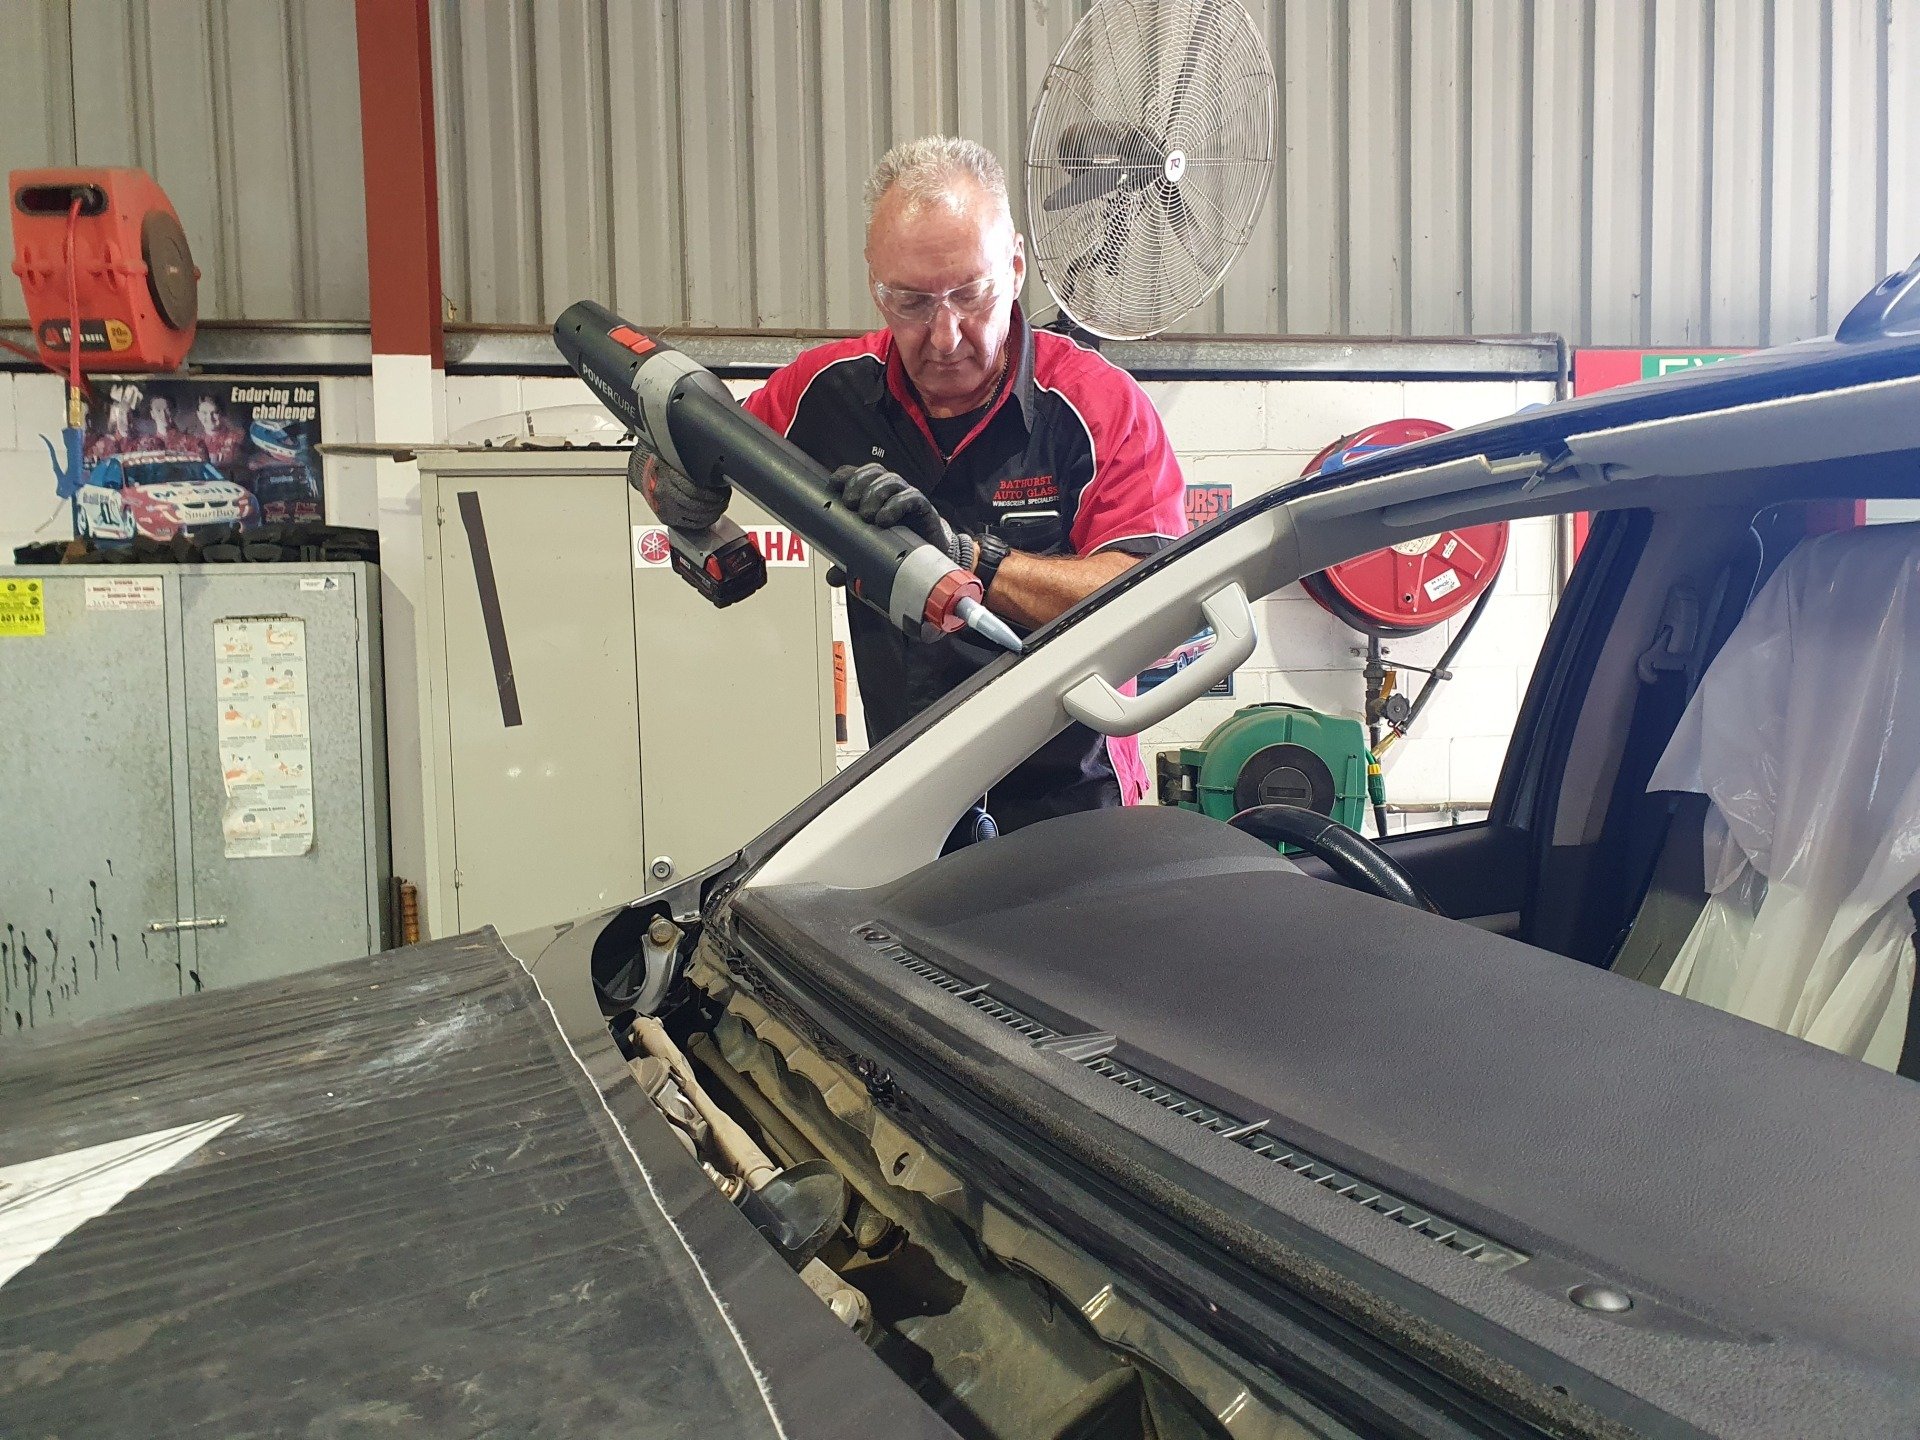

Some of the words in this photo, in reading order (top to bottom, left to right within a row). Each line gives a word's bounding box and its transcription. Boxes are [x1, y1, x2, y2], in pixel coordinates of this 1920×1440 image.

[231, 386, 290, 405] Enduring
[294, 387, 315, 403] the
[582, 362, 636, 419] POWERCURE
[252, 404, 316, 423] challenge
[871, 445, 886, 458] Bill
[1000, 475, 1053, 490] BATHURST
[993, 490, 1023, 501] AUTO
[1026, 485, 1058, 499] GLASS
